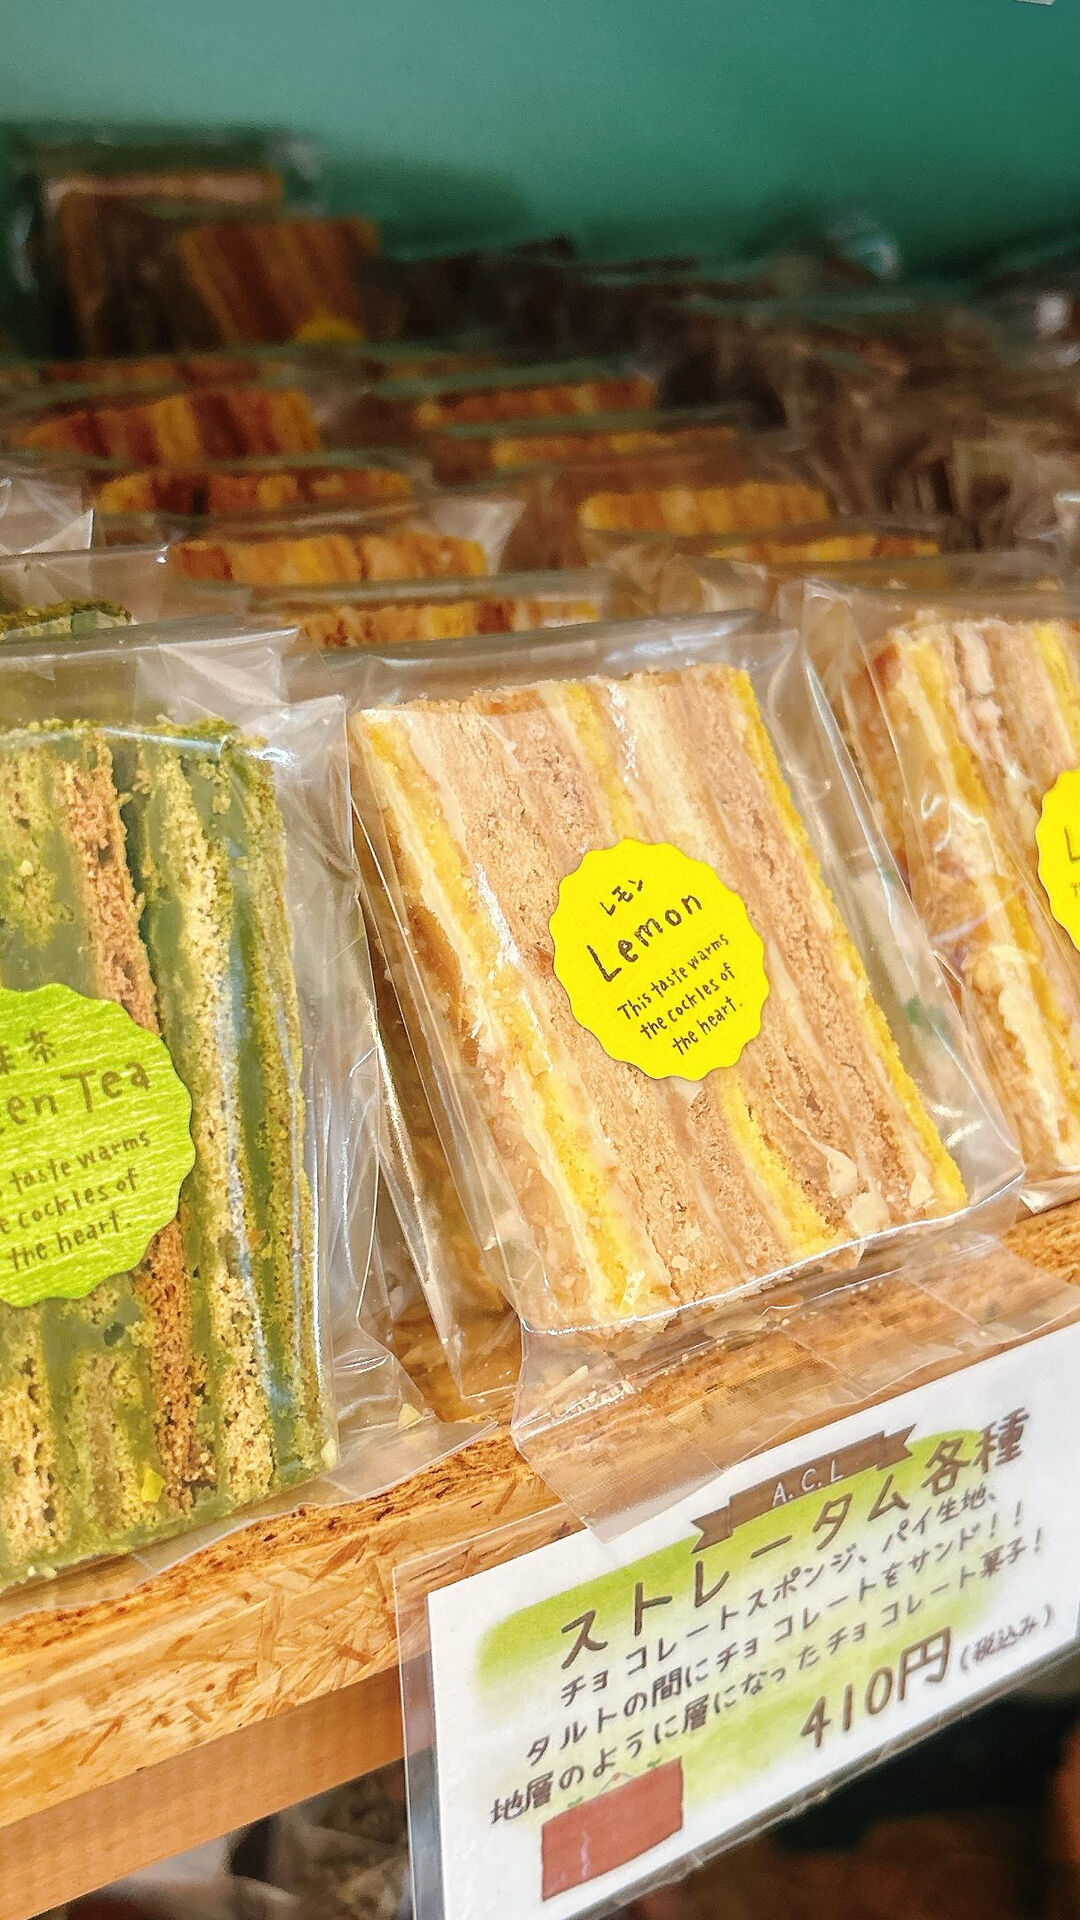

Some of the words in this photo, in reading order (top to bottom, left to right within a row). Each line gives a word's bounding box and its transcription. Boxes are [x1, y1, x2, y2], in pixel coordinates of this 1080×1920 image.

[600, 879, 643, 916] レモン
[587, 894, 703, 982] Lemon
[617, 992, 652, 1020] This
[651, 967, 688, 998] taste
[688, 934, 729, 970] warms
[640, 1016, 667, 1039] the
[668, 979, 720, 1022] cockles
[721, 962, 735, 983] of
[672, 1030, 698, 1055] the
[699, 996, 743, 1035] heart.
[61, 1061, 150, 1113] Tea
[10, 1159, 71, 1195] taste
[78, 1130, 151, 1170] warms
[19, 1187, 109, 1230] cockles
[115, 1167, 139, 1193] of
[9, 1242, 48, 1272] the
[57, 1209, 132, 1249] heart.
[561, 1407, 1030, 1669] ストレータム各種
